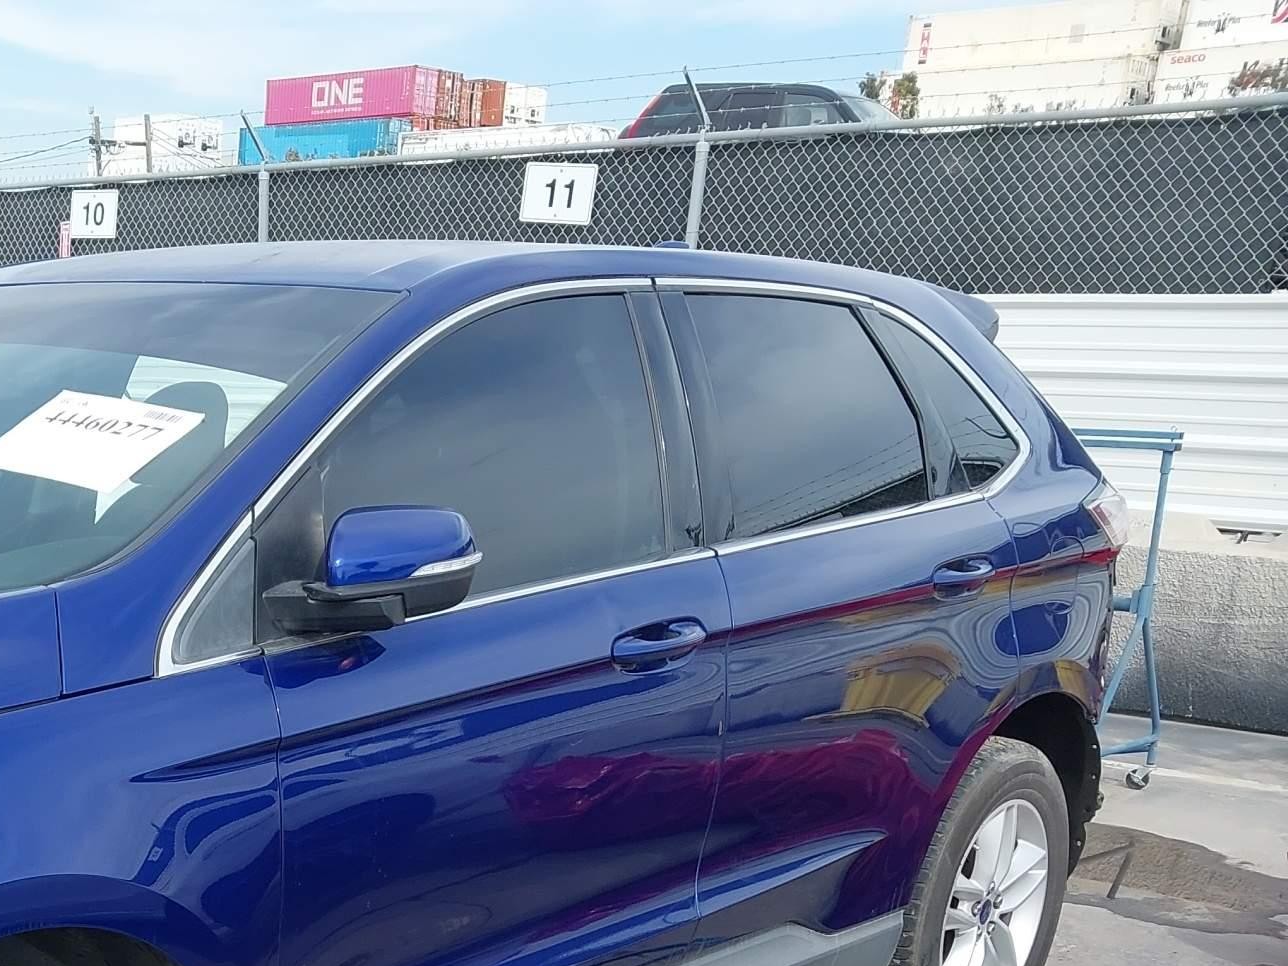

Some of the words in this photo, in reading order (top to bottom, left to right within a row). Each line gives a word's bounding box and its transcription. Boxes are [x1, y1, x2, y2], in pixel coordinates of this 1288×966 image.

[1170, 53, 1206, 64] seaco
[311, 77, 364, 107] ONE
[545, 178, 575, 209] 11
[83, 202, 105, 226] 10
[45, 410, 165, 441] 44460277
